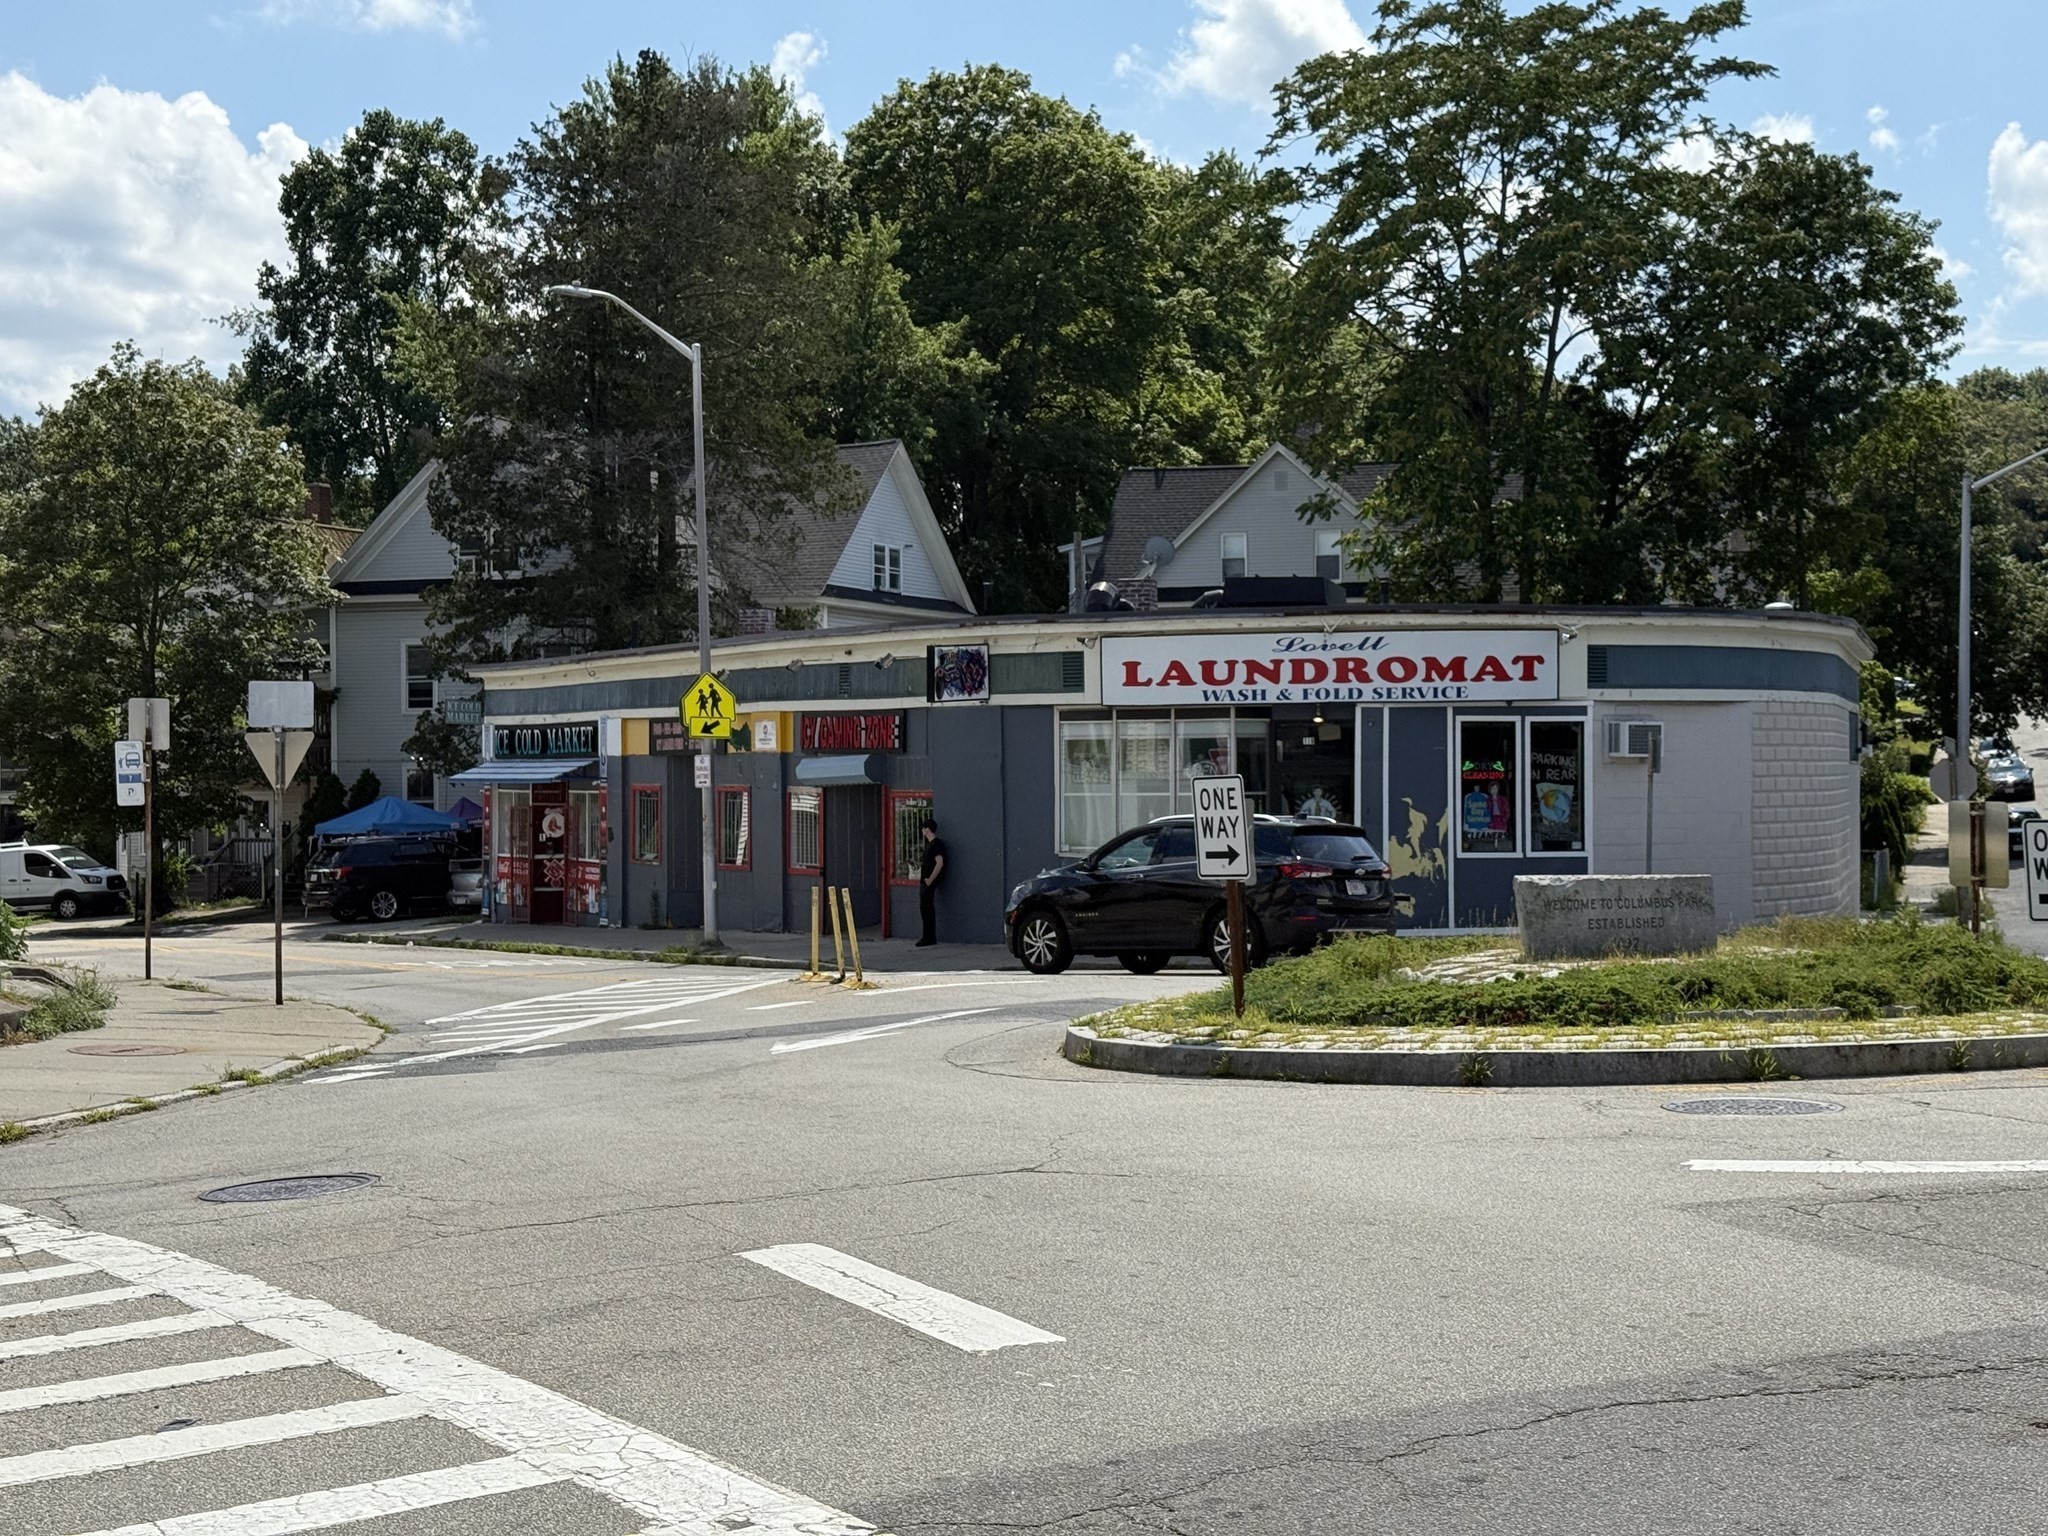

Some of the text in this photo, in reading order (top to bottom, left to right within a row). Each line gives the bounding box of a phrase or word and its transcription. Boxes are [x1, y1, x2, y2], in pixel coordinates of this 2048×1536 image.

[1272, 636, 1390, 652] Lovell
[1121, 655, 1545, 687] LAUNDROMAT
[1202, 686, 1469, 702] WASH & FOLD SERVICE
[447, 701, 481, 712] ICE COLD
[447, 712, 480, 723] MARKET
[820, 715, 862, 749] GAMING
[865, 715, 895, 749] ZONE
[494, 730, 509, 755] ICE
[515, 729, 542, 755] COLD
[547, 726, 594, 754] MARKET
[1531, 752, 1576, 768] PARKING
[1532, 768, 1577, 780] N REAR
[1200, 787, 1238, 811] ONE
[1201, 815, 1240, 839] WAY
[1543, 897, 1597, 911] WELCOME
[1600, 898, 1614, 910] TO
[1617, 897, 1675, 910] COLUMBUS
[1587, 917, 1665, 930] ESTABLISHED
